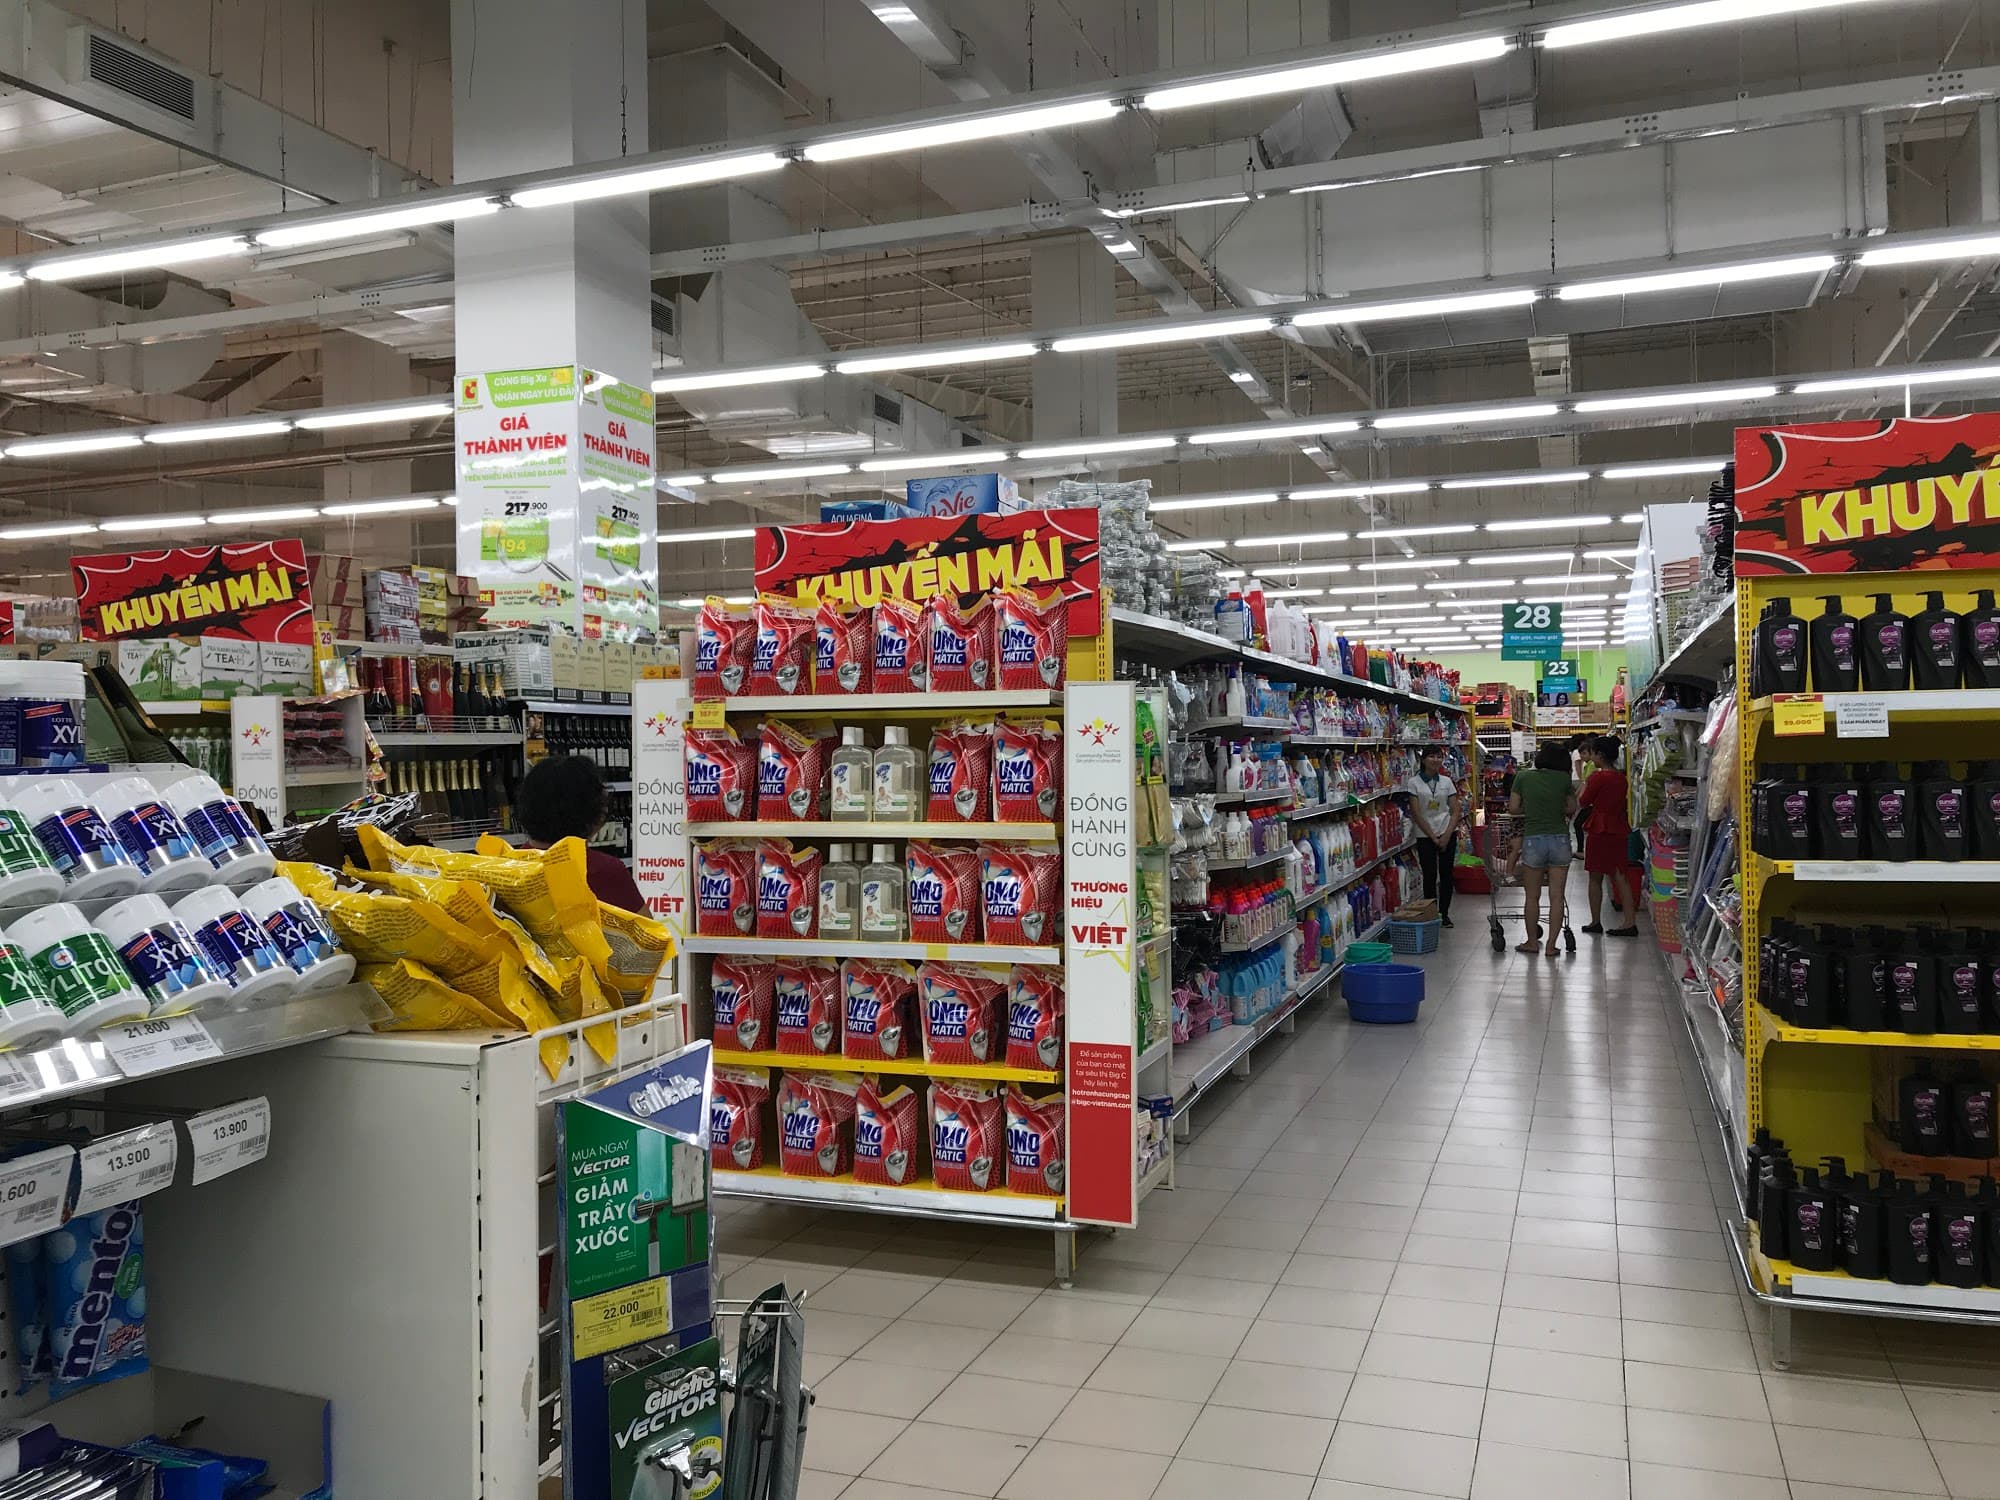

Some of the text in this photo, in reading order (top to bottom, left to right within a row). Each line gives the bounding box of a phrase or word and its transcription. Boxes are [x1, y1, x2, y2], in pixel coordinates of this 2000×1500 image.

[500, 412, 529, 431] GIÁ
[608, 421, 628, 440] GIÁ
[464, 432, 567, 455] THÀNH VIÊN
[584, 433, 650, 468] THÀNH VIÊN
[505, 502, 548, 516] 217.900
[796, 529, 1065, 608] KHUYẾN MÃI
[100, 562, 294, 635] KHUYẾN MÃI
[1514, 605, 1552, 629] 28
[320, 632, 332, 645] 29
[876, 634, 907, 654] OMO
[933, 630, 967, 651] OMO
[1001, 629, 1036, 650] OMO
[876, 656, 903, 667] MATIC
[933, 653, 963, 665] MATIC
[1002, 650, 1033, 661] MATIC
[1548, 661, 1570, 676] 23
[687, 761, 721, 781] OMO
[999, 760, 1034, 781] OMO
[688, 783, 717, 794] MATIC
[759, 783, 782, 794] MATIC
[1000, 782, 1030, 793] MATIC
[639, 799, 684, 815] HÀNH
[1071, 816, 1126, 834] HÀNH
[1071, 839, 1127, 857] CÙNG
[638, 857, 685, 868] THƯƠNG
[638, 871, 665, 883] HIỆU
[700, 876, 732, 897] OMO
[759, 876, 792, 898] OMO
[1071, 881, 1129, 893] THƯƠNG
[909, 880, 943, 901] OMO
[985, 880, 1021, 902] OMO
[645, 893, 685, 917] VIỆT
[701, 898, 727, 910] MATIC
[759, 899, 784, 911] MATIC
[911, 903, 938, 915] MATIC
[987, 903, 1015, 916] MATIC
[1071, 896, 1103, 910] HIỆU
[1071, 922, 1128, 949] VIỆT
[778, 993, 810, 1013] OMO
[847, 996, 881, 1019] OMO
[929, 999, 969, 1023] OMO
[778, 1015, 805, 1026] MATIC
[1009, 1002, 1042, 1026] OMO
[124, 1020, 170, 1039] 21.800
[847, 1021, 873, 1033] MATIC
[931, 1025, 963, 1036] MATIC
[1008, 1026, 1032, 1039] MATIC
[1108, 1071, 1121, 1080] Big
[628, 1073, 702, 1118] Gillette
[711, 1108, 732, 1130] MO
[784, 1113, 820, 1137] OMO
[213, 1119, 248, 1141] 13.900
[934, 1124, 969, 1149] OMO
[1007, 1128, 1040, 1152] OMO
[571, 1139, 630, 1162] MUA NGAY
[784, 1137, 812, 1148] MATIC
[107, 1147, 151, 1172] 13.900
[573, 1154, 631, 1177] VECTOR
[935, 1150, 962, 1162] MATIC
[575, 1176, 629, 1204] GIẢM
[578, 1199, 626, 1229] TRẦY
[575, 1225, 630, 1255] XƯỚC
[603, 1300, 640, 1320] 22.000
[644, 1366, 716, 1415] Gillette
[614, 1387, 718, 1450] VECTOR
